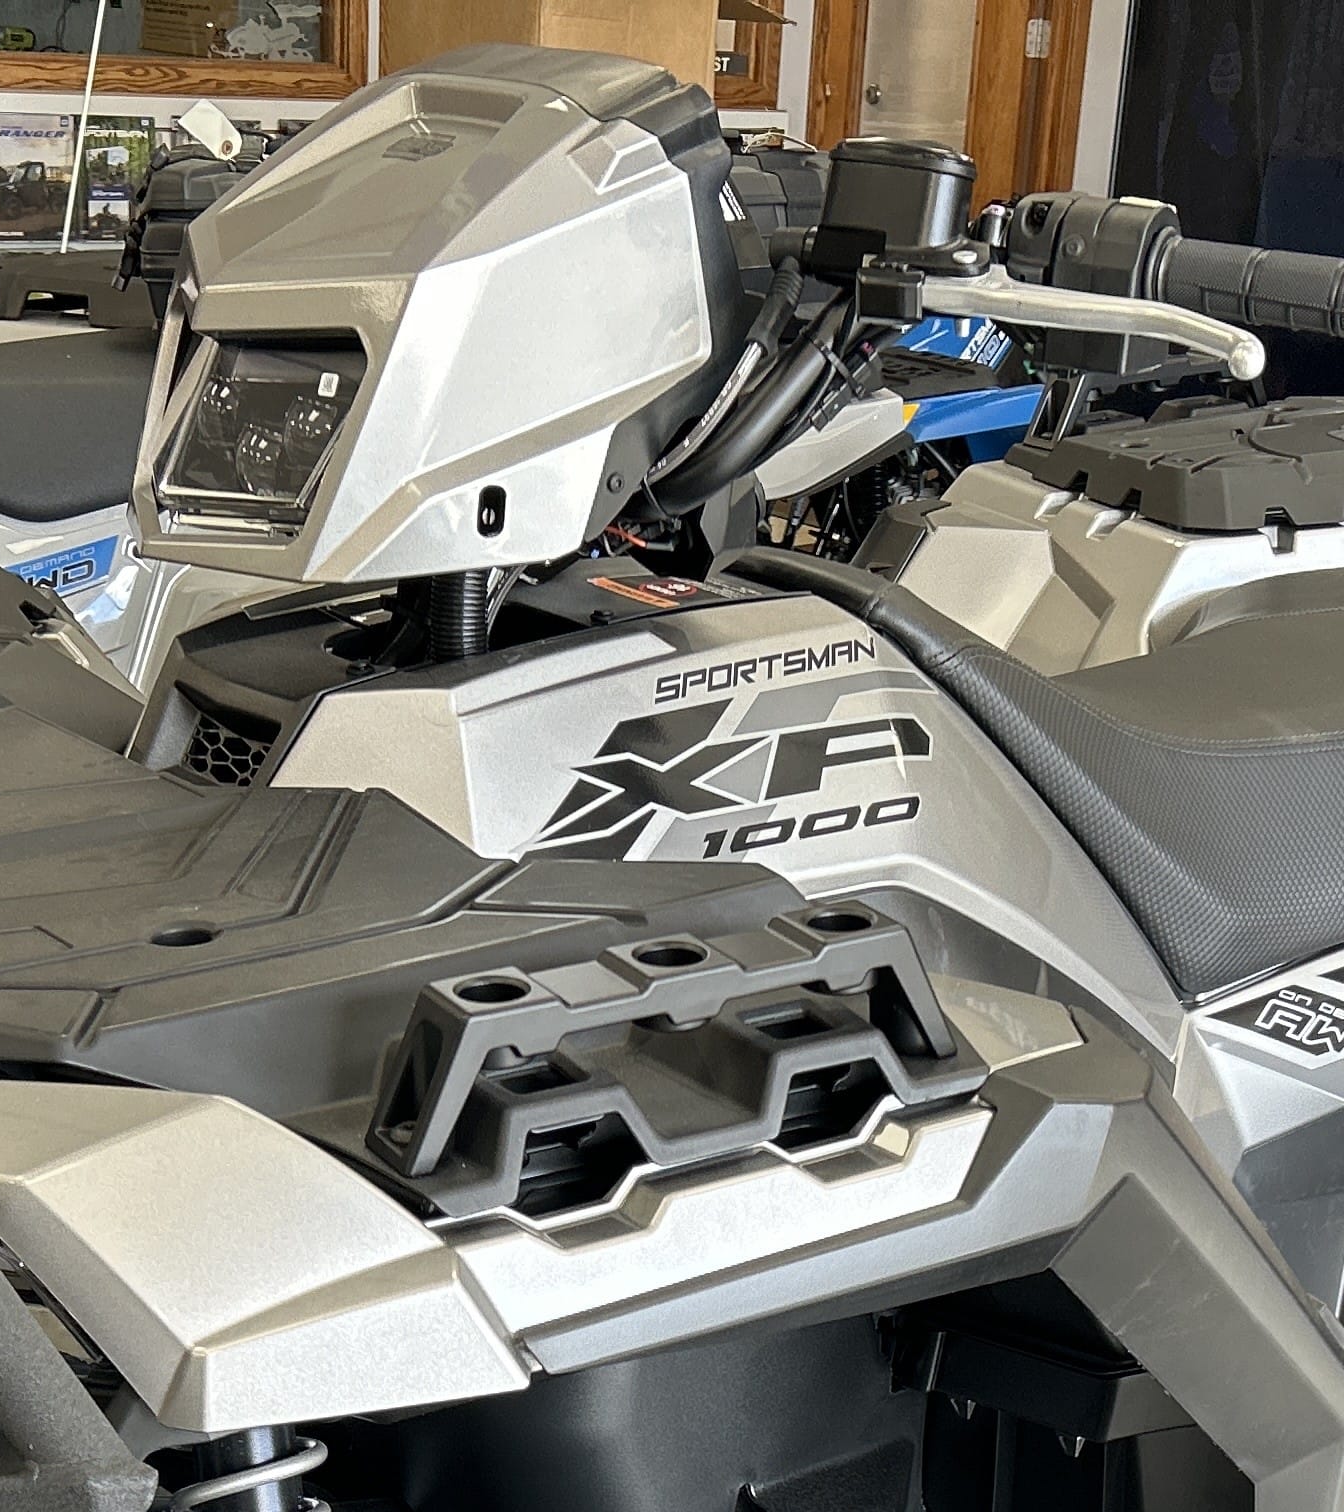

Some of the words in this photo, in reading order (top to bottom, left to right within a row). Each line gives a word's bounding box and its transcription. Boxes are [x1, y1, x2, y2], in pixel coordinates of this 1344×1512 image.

[655, 637, 876, 705] SPORTSMAN
[702, 795, 921, 859] 1000
[1277, 988, 1313, 1007] ON
